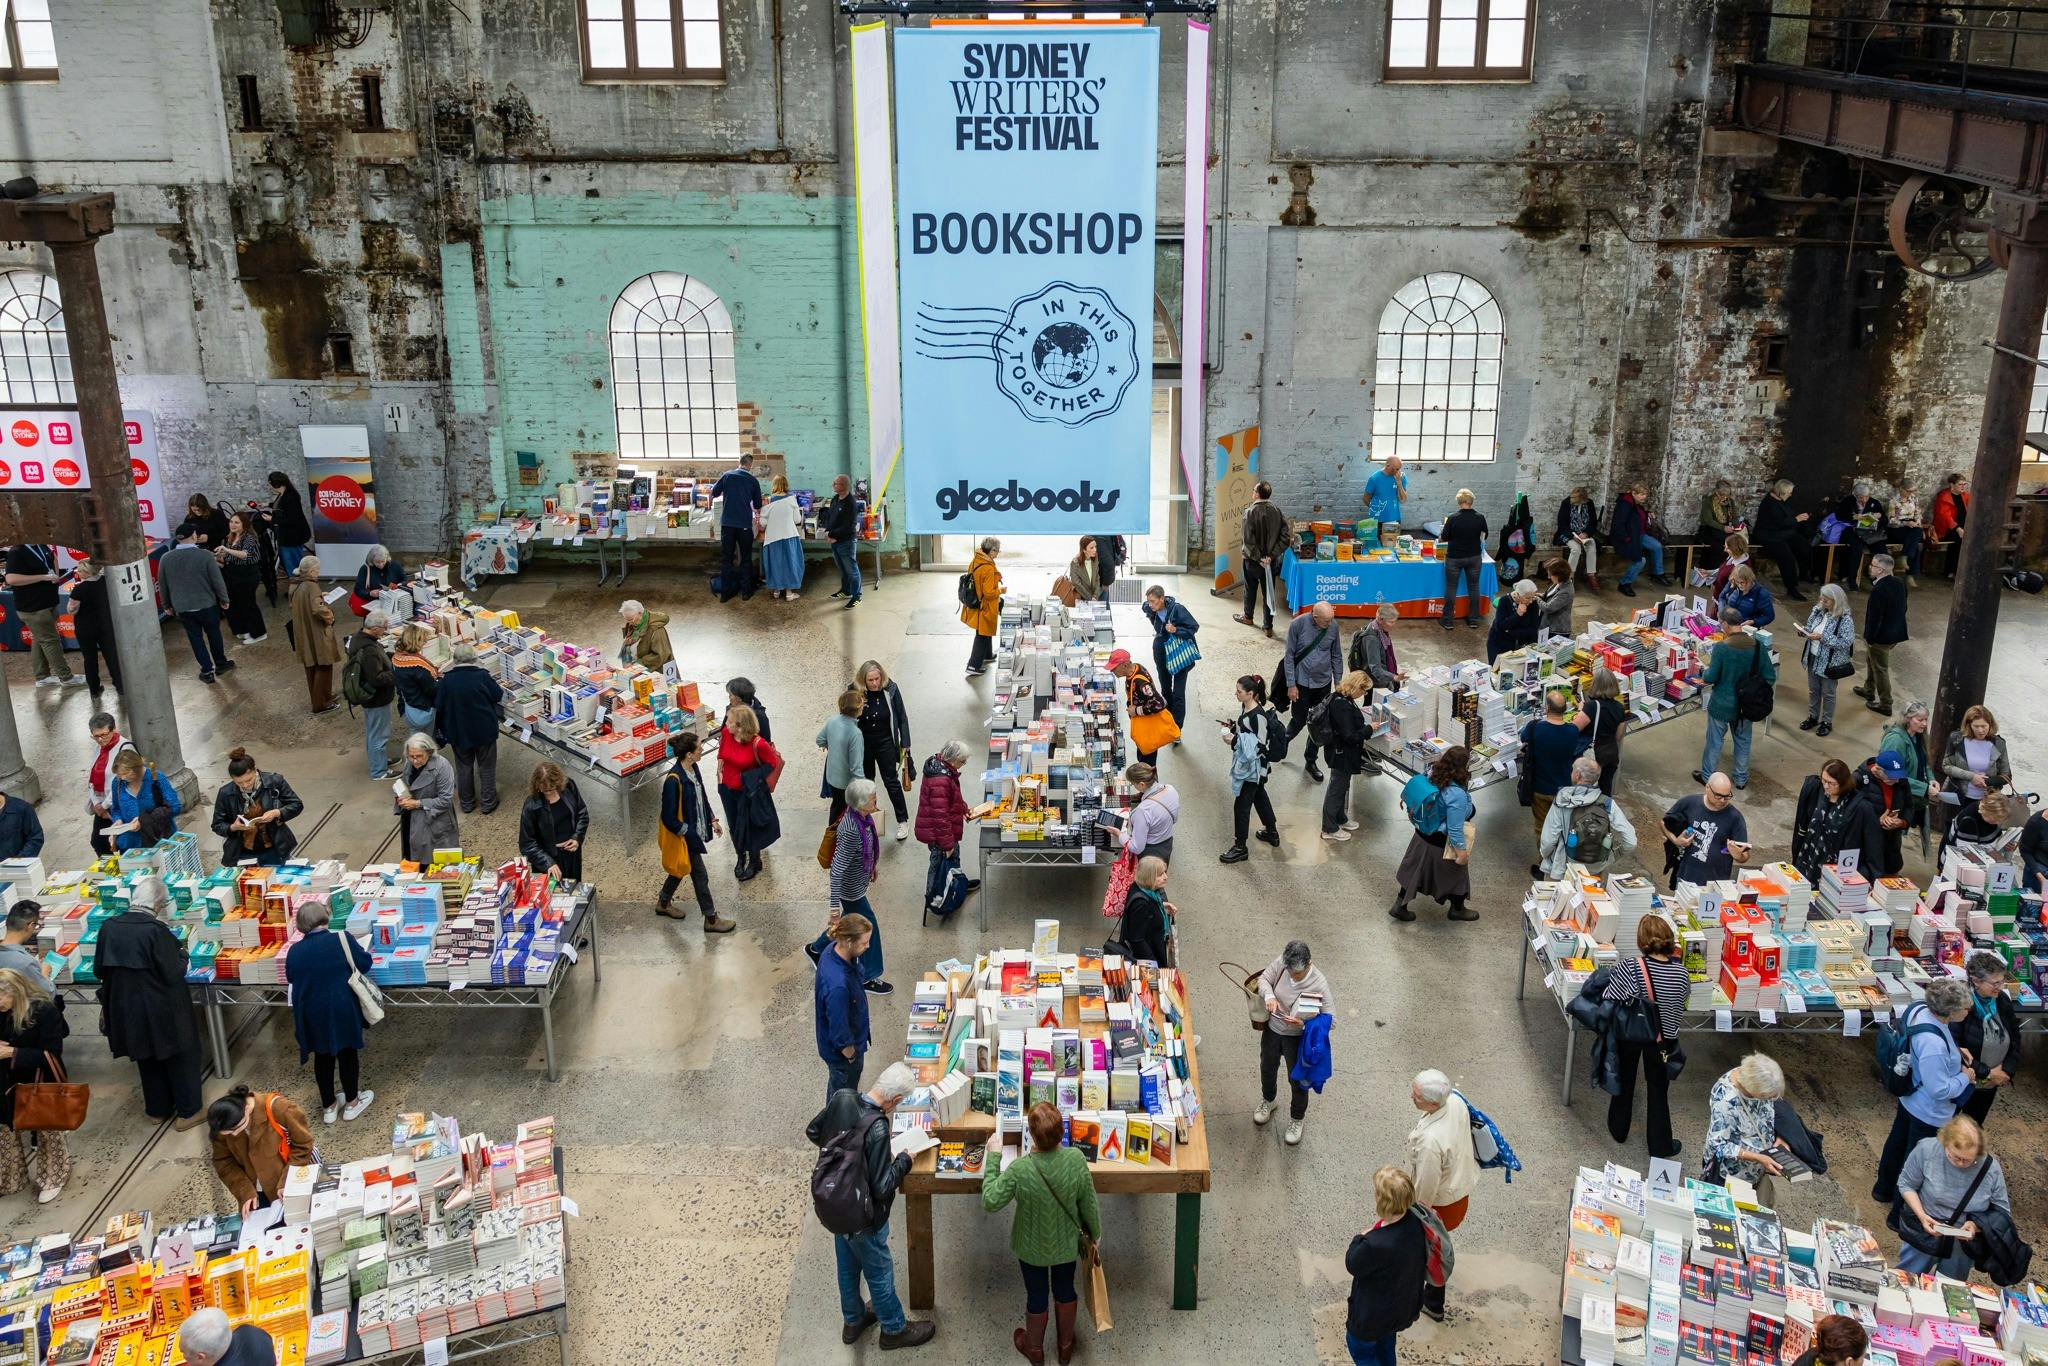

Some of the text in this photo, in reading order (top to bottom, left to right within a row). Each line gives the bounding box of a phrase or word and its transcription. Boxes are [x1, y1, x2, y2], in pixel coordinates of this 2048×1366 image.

[964, 43, 1090, 78] SYDNEY
[956, 116, 1099, 150] FESTIVAL
[912, 212, 1143, 255] BOOKSHOP
[1042, 299, 1118, 342] IN THIS
[1010, 352, 1105, 411] TOGETHER
[329, 490, 351, 498] Radio
[936, 480, 1120, 520] gleebooks
[320, 498, 362, 507] SYDNEY
[121, 564, 141, 584] J1
[1316, 574, 1359, 586] Reading
[130, 584, 144, 602] 2
[1316, 584, 1349, 592] opens
[1316, 591, 1346, 601] doors
[1696, 602, 1703, 611] K
[595, 659, 602, 668] P
[1453, 669, 1460, 679] H
[1842, 856, 1854, 867] G
[1997, 872, 2008, 883] E
[1705, 901, 1715, 912] D
[1655, 1169, 1671, 1184] A
[169, 1243, 183, 1259] Y
[1718, 1263, 1748, 1277] ENTITLEMENT
[1753, 1260, 1784, 1275] ENTITLEMENT
[1682, 1268, 1712, 1281] ENTITLEMENT
[107, 1280, 119, 1315] BUTTER
[54, 1302, 84, 1315] BUTTER
[155, 1291, 166, 1325] BUTTER
[54, 1311, 85, 1322] BUTTER
[101, 1323, 131, 1334] BUTTER
[1682, 1326, 1712, 1340] ENTITLEMENT
[1751, 1319, 1782, 1336] ENTITLEMENT
[1714, 1334, 1745, 1348] ENTITLEMENT
[0, 1352, 28, 1365] EUREKA
[1978, 1355, 2003, 1366] WANT
